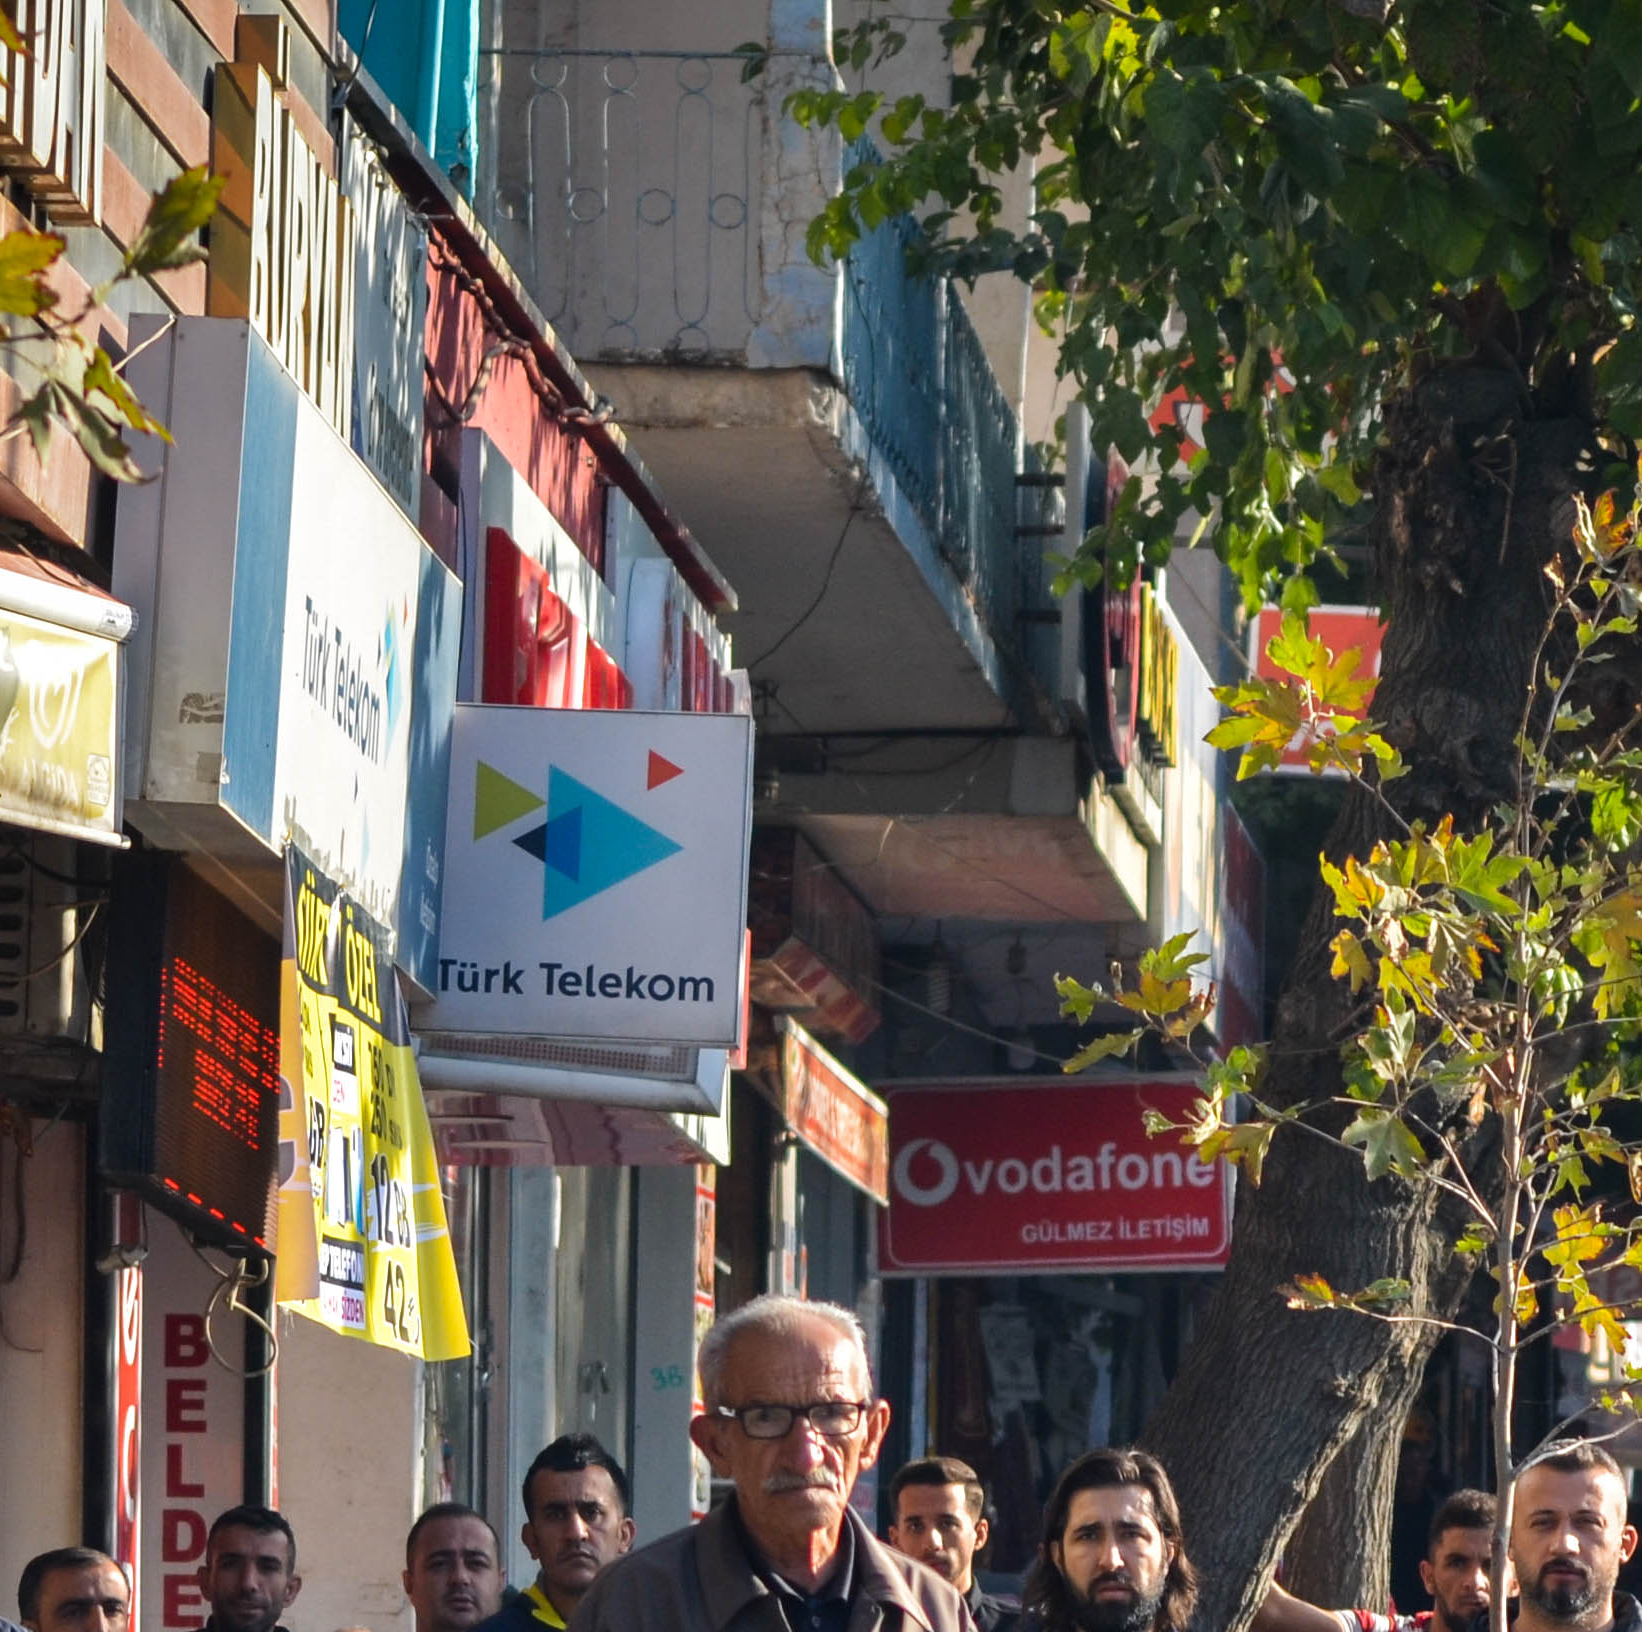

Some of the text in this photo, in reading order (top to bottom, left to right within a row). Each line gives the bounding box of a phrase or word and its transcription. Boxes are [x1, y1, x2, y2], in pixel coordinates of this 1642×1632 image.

[302, 594, 381, 766] Türk Telekom
[439, 959, 715, 1003] Türk Telekom
[963, 1141, 1215, 1197] vodafone
[1021, 1214, 1209, 1244] GÜLMEZ İLETİŞİM
